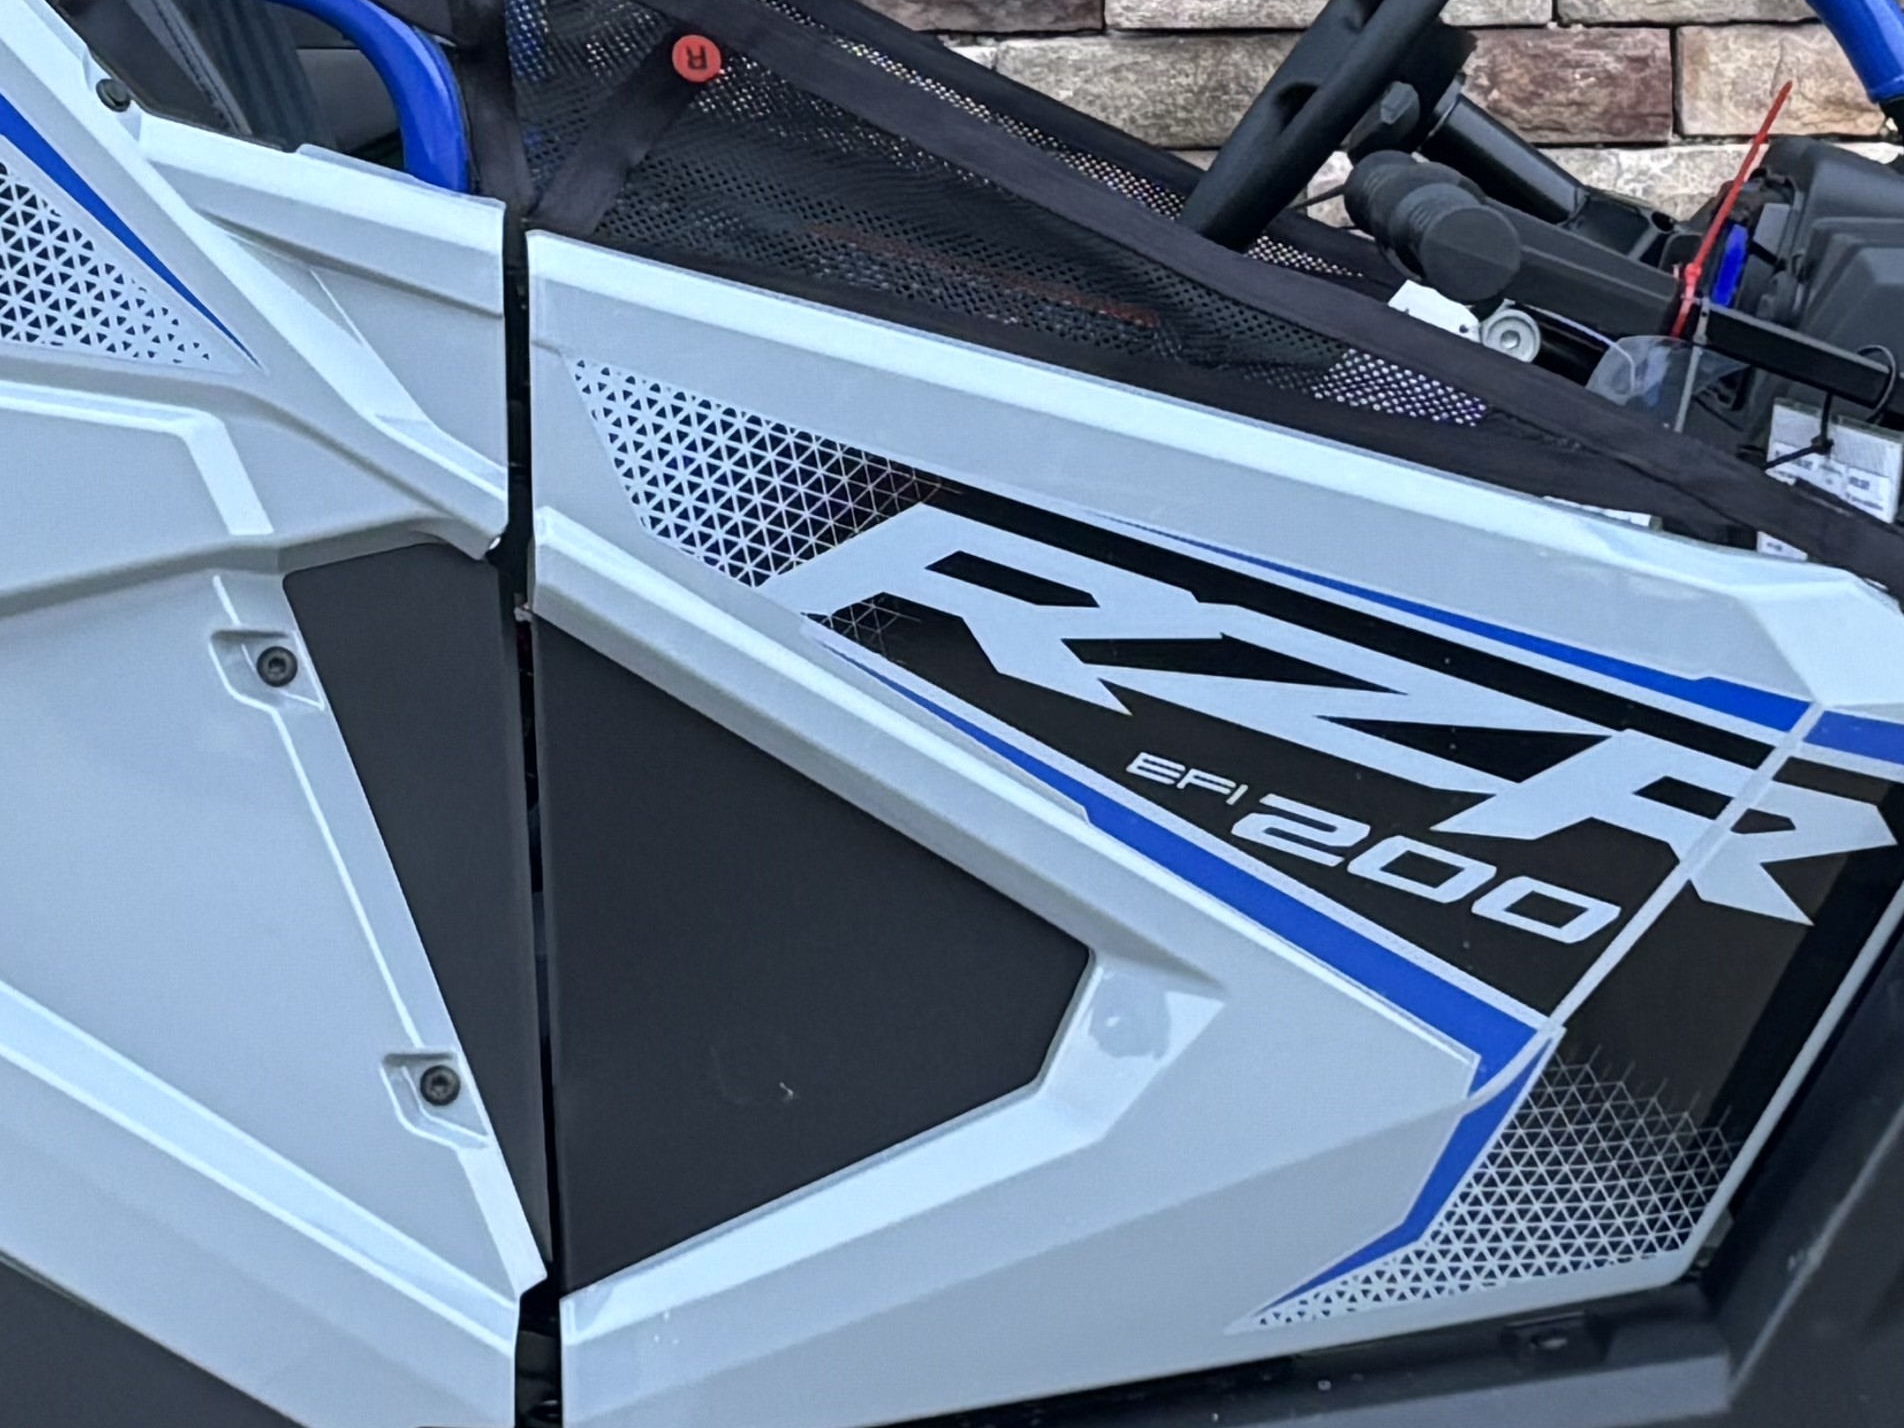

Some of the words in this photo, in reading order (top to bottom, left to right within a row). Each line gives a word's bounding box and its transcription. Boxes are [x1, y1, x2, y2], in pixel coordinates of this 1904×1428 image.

[760, 503, 1898, 925] RZR
[1125, 752, 1249, 806] EFI
[1230, 791, 1621, 944] 200
